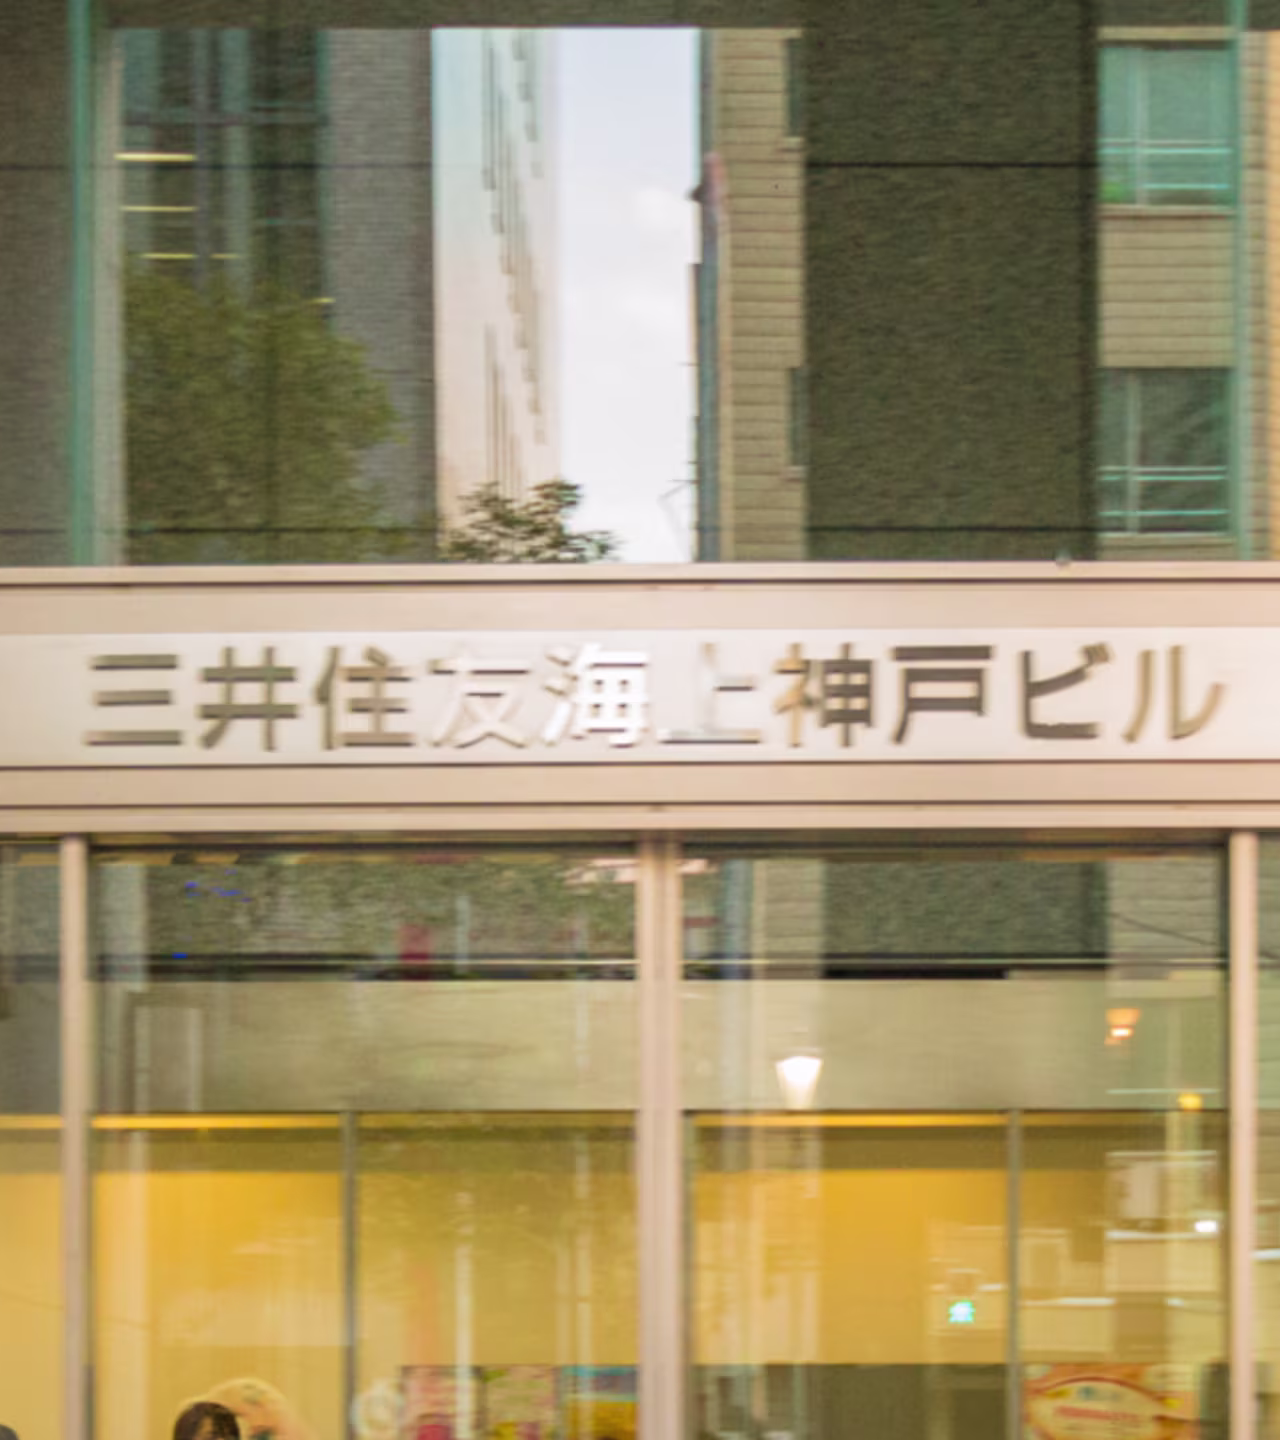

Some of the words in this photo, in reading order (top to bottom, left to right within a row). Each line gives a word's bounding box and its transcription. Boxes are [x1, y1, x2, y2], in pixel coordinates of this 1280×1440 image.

[83, 642, 1226, 751] 三井住友海上神戸ビル
